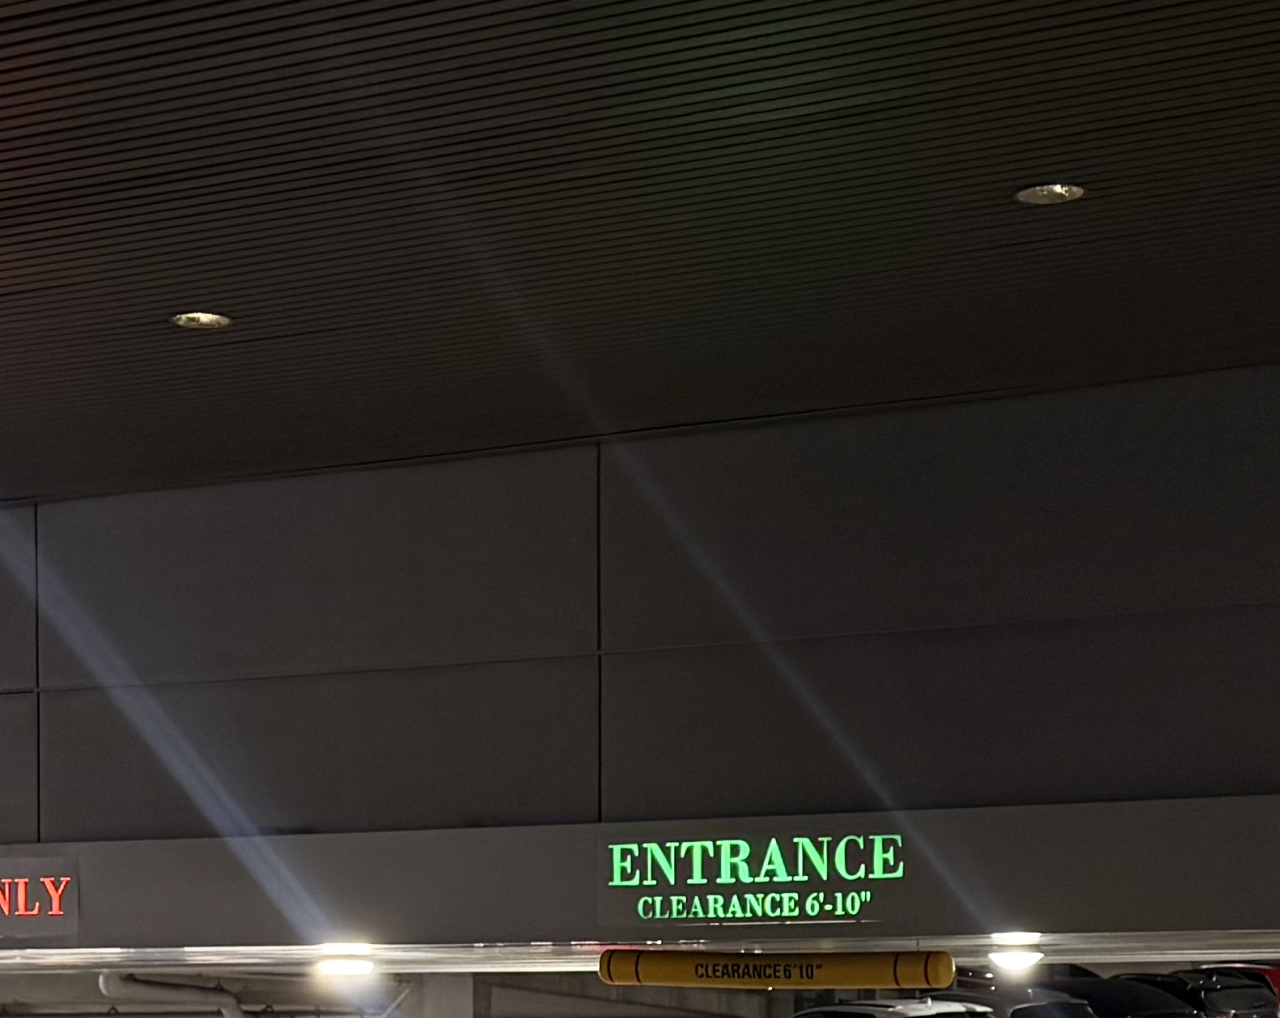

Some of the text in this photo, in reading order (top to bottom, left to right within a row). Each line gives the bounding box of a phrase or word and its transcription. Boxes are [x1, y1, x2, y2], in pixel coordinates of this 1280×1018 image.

[608, 834, 904, 886] ENTRANCE
[638, 891, 872, 920] CLEARANCE 6'-10"
[694, 963, 782, 980] CLEARANCE
